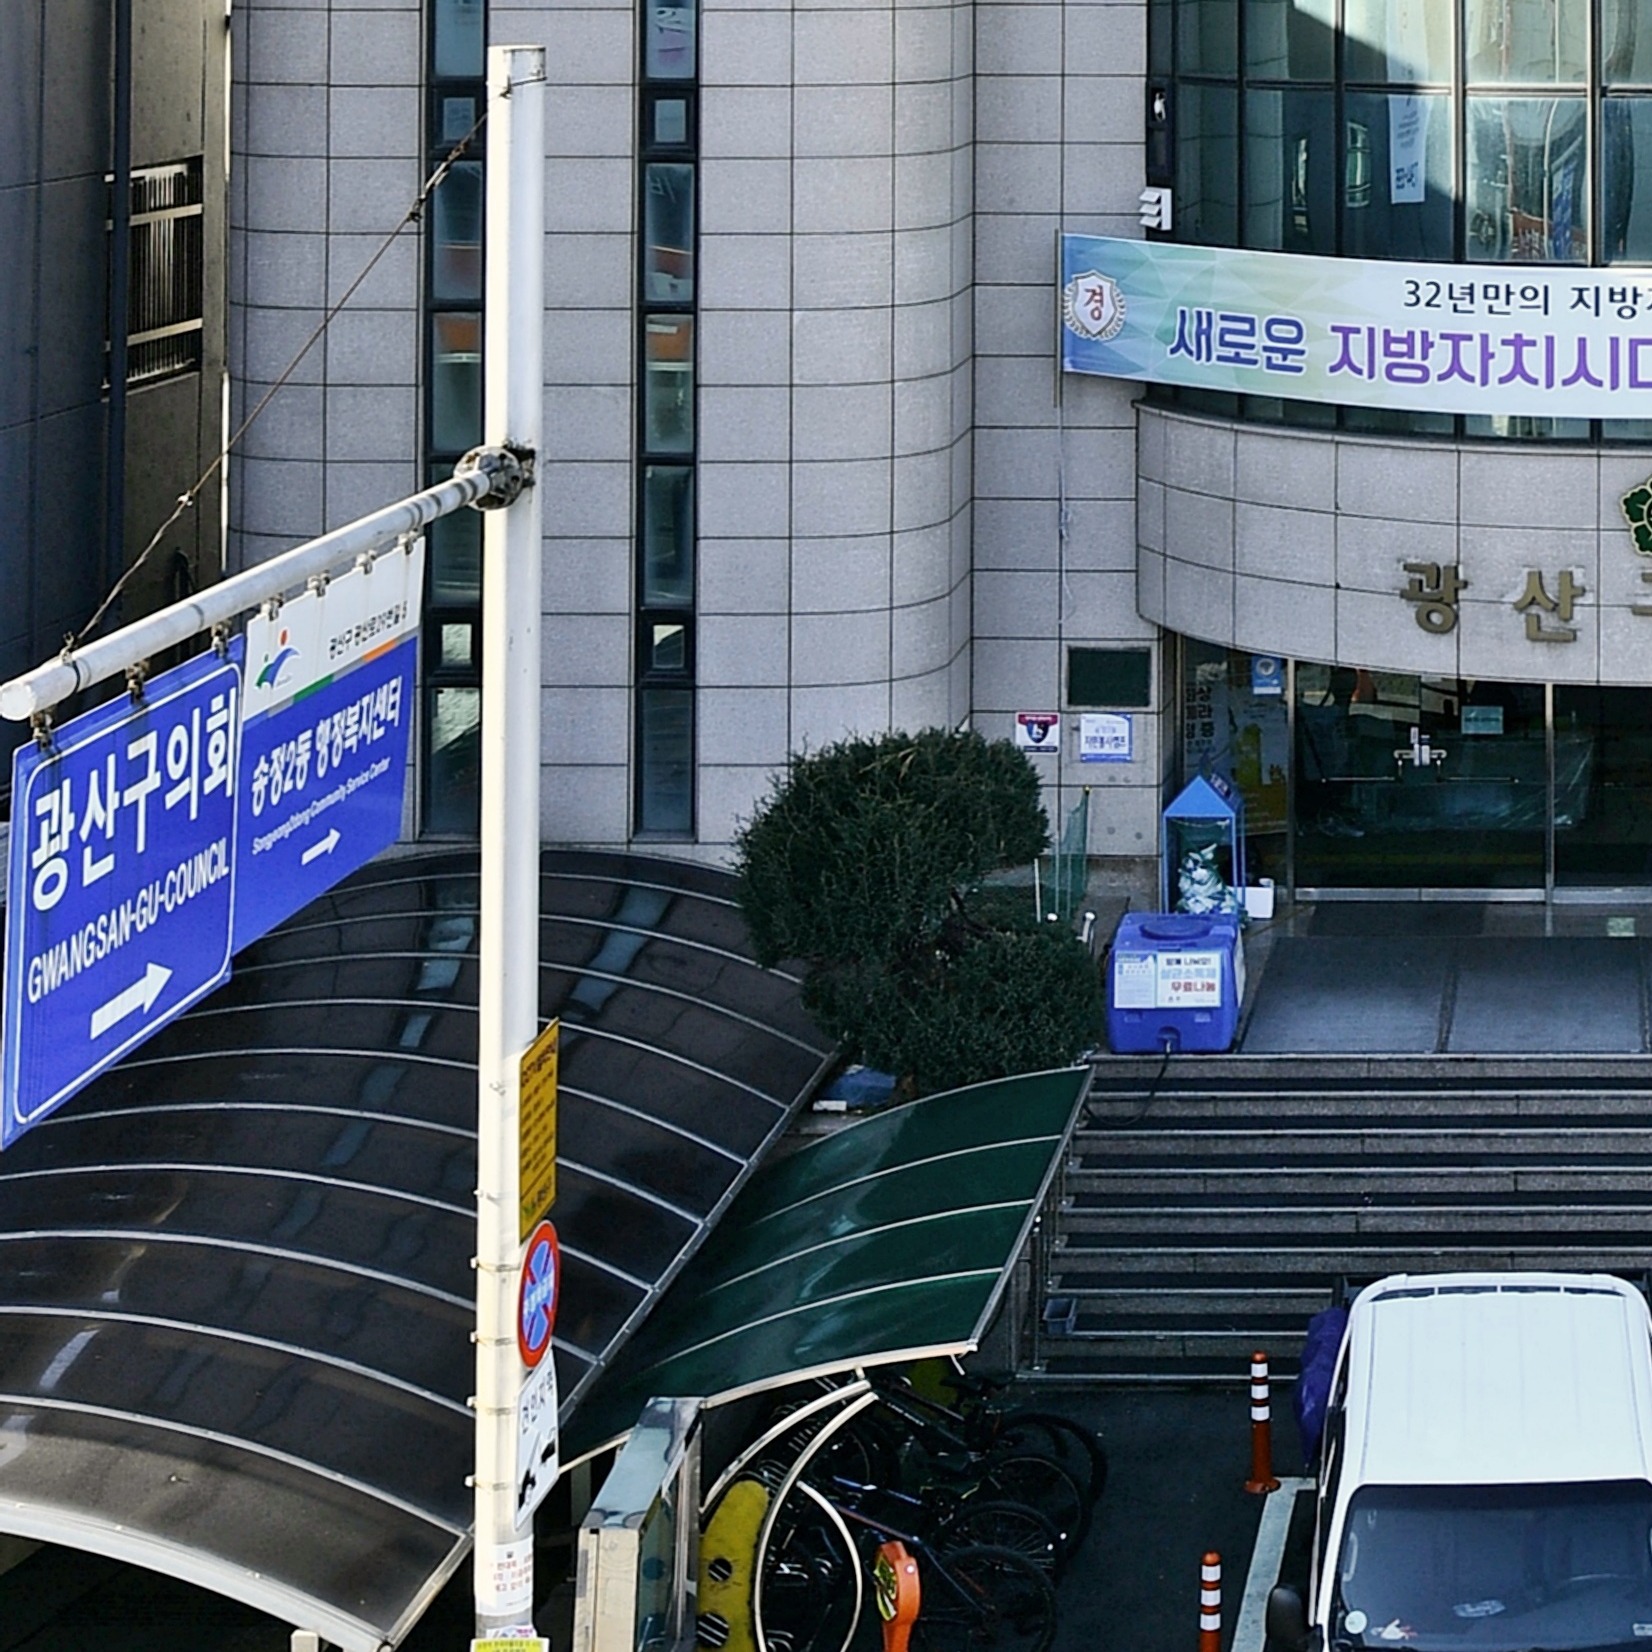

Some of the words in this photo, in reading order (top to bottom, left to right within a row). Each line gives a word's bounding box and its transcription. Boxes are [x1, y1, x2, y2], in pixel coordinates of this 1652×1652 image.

[1083, 283, 1107, 323] 경
[1167, 308, 1307, 374] 새로운
[1403, 279, 1550, 317] 32년만의
[251, 728, 313, 818] 송정2동
[315, 675, 403, 779] 행정복지센터
[32, 686, 235, 912] 광산구의회
[27, 836, 229, 1004] GWANGSAN-GU-COUNCIL
